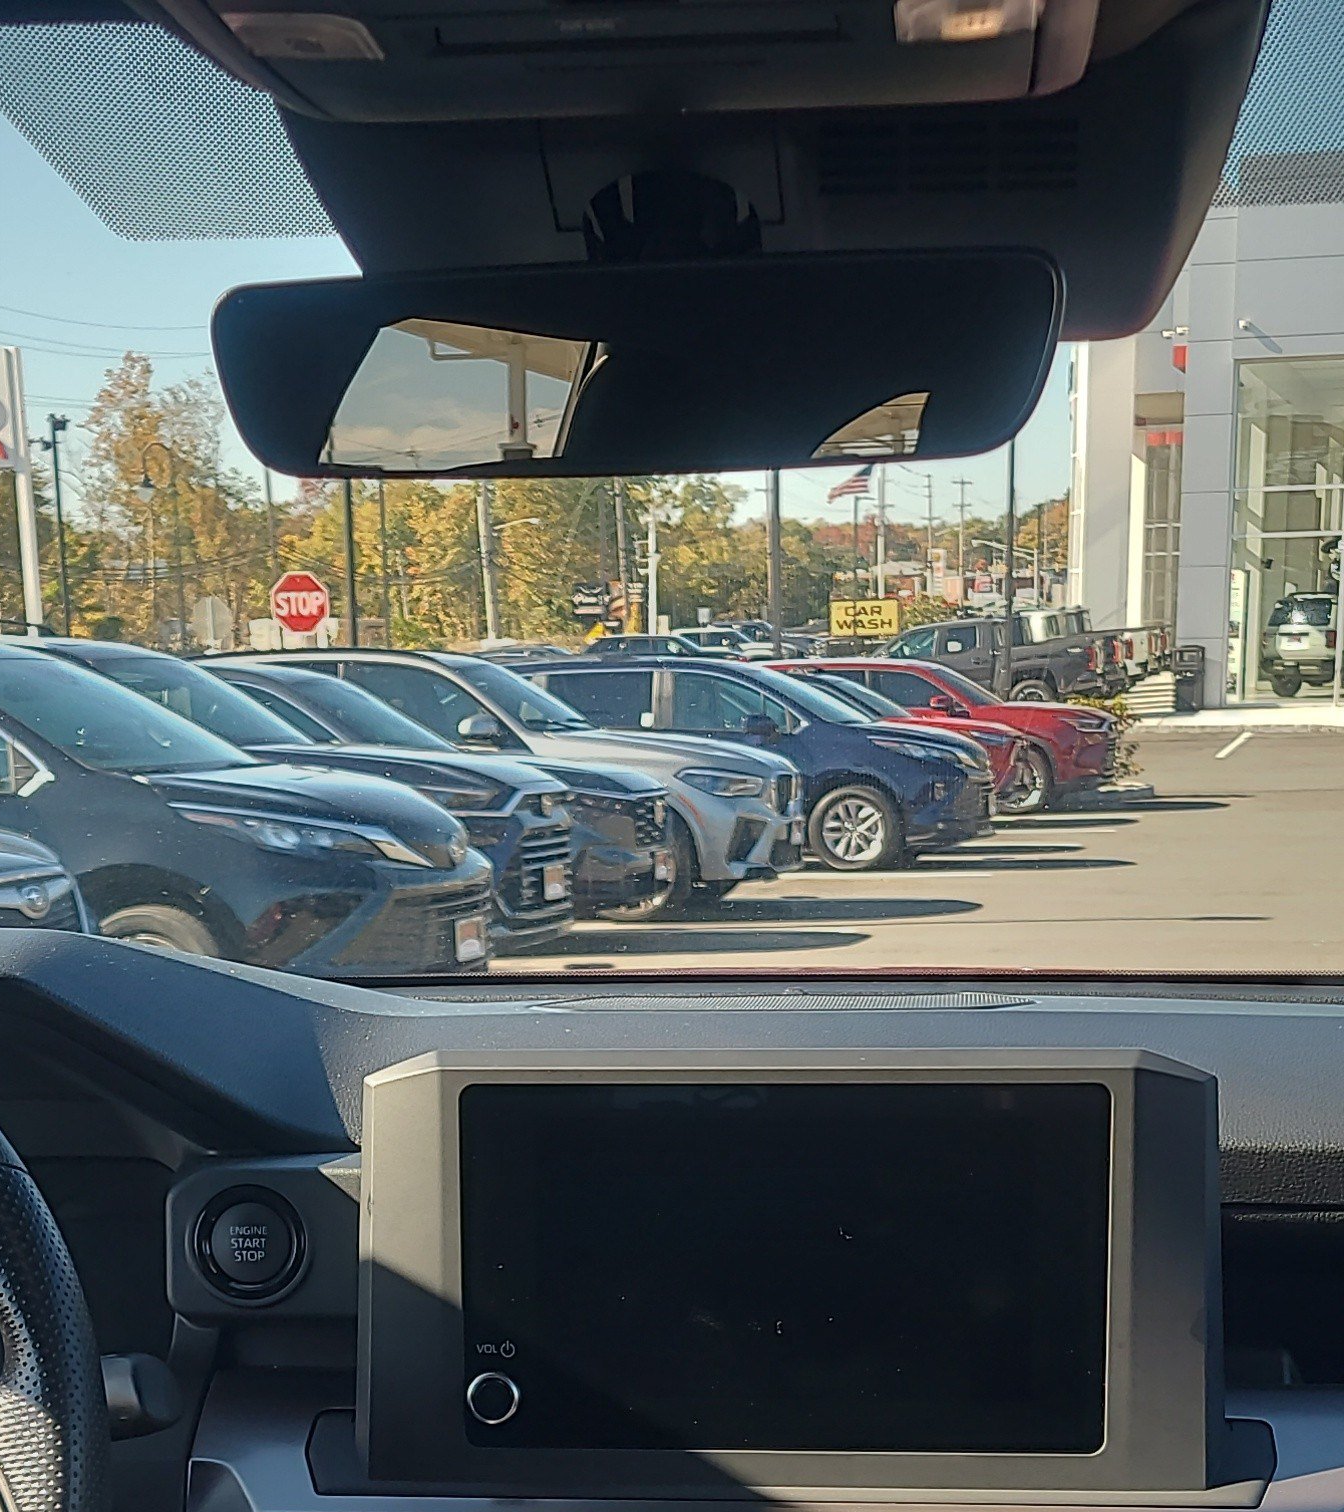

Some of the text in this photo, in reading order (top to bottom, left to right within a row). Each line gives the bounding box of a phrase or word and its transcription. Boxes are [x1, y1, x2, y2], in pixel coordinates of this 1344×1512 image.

[276, 592, 325, 616] STOP
[844, 605, 883, 617] CAR
[836, 618, 893, 631] WASH
[229, 1225, 268, 1236] ENGINE
[230, 1238, 266, 1249] START
[234, 1250, 265, 1262] STOP
[476, 1343, 498, 1354] VOL
